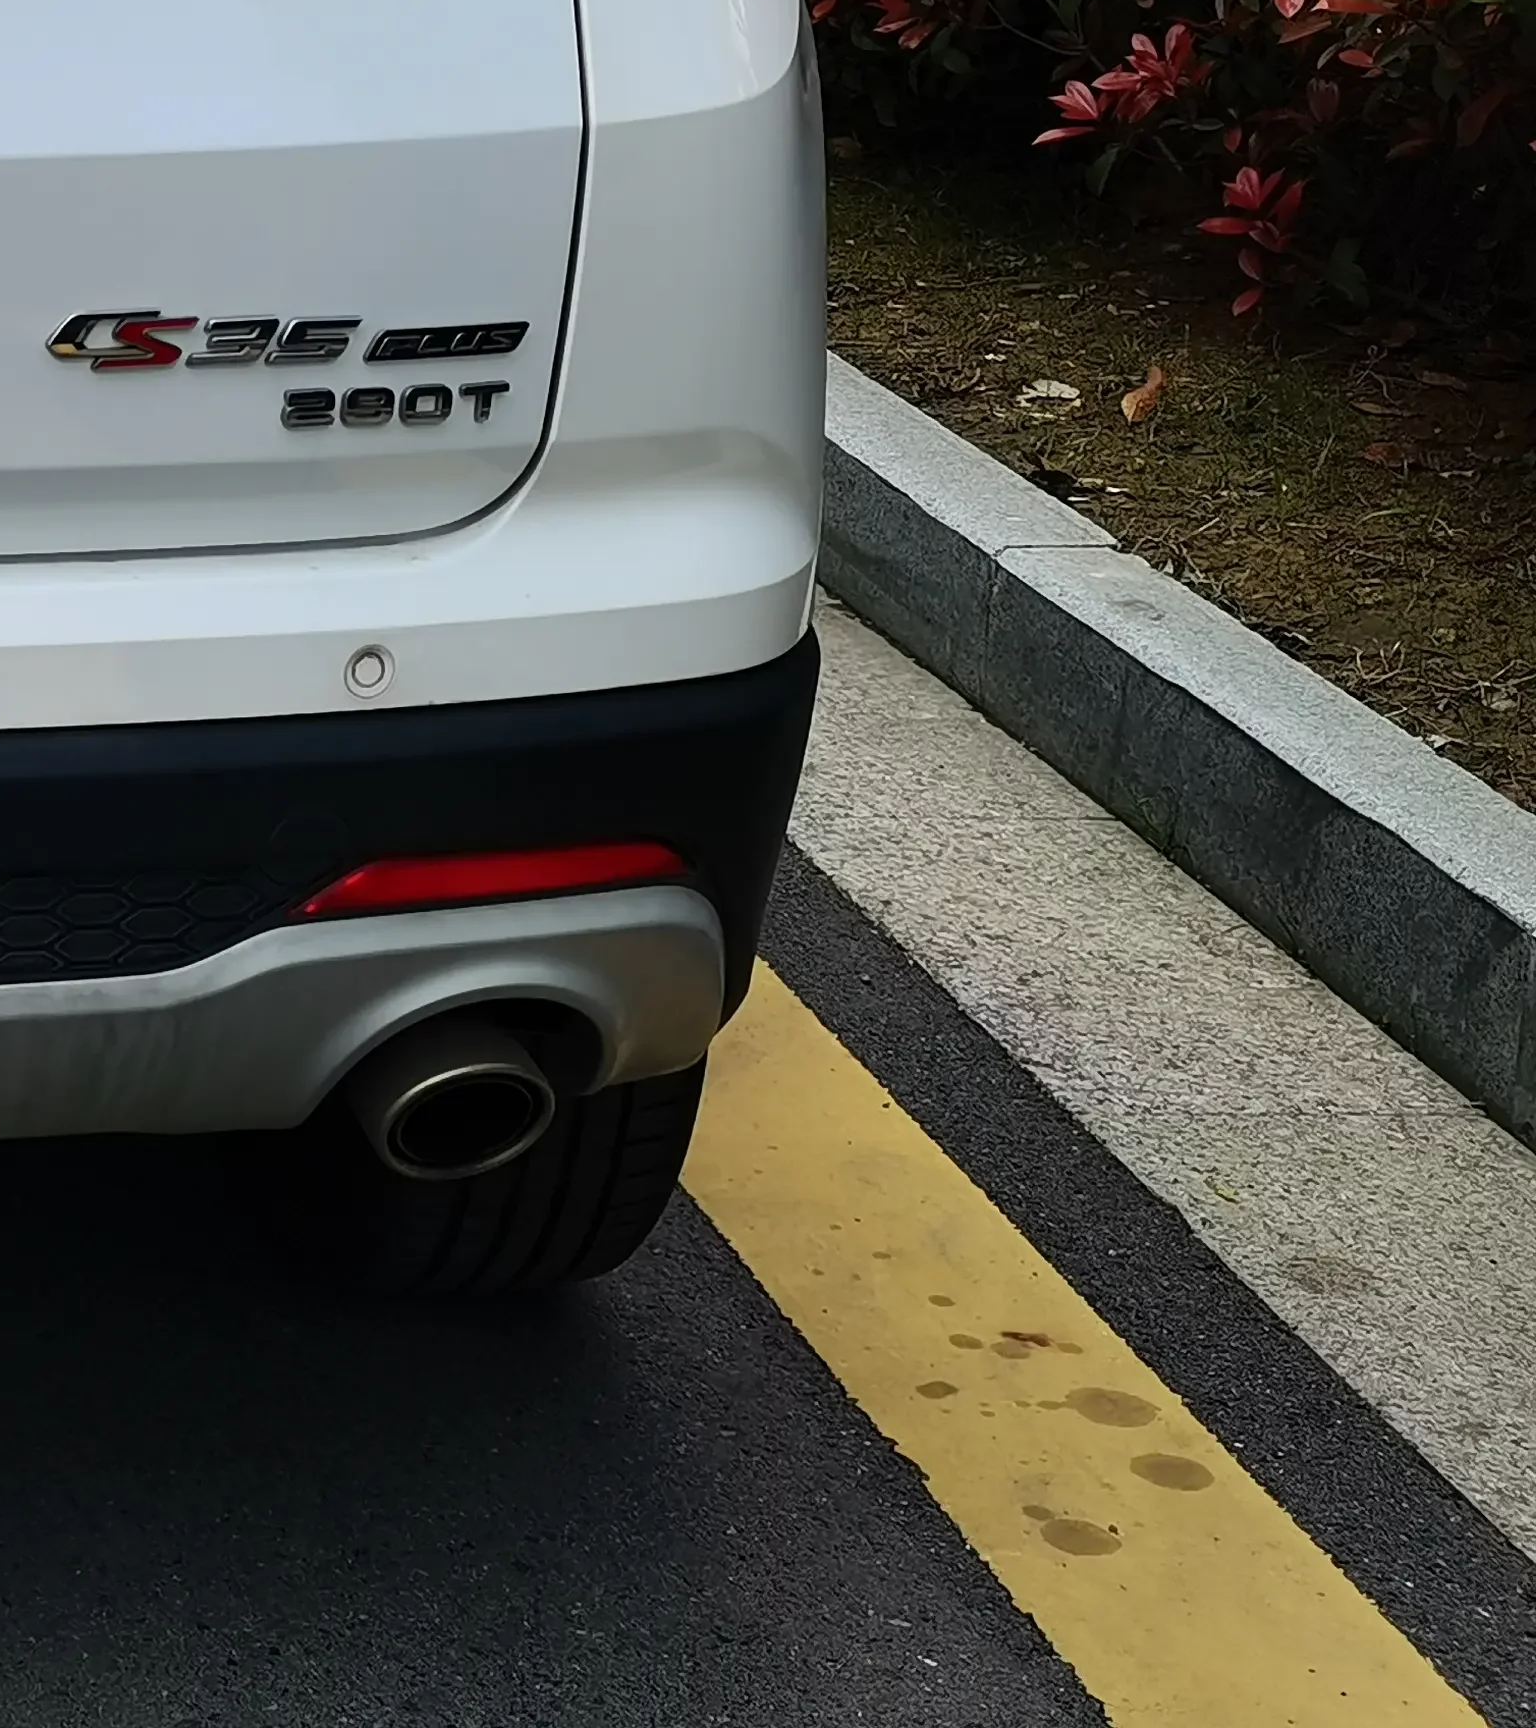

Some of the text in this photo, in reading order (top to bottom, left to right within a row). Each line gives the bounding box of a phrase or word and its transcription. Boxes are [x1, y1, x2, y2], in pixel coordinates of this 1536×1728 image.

[45, 309, 525, 373] CS35 PLUS
[280, 380, 511, 431] 280T
